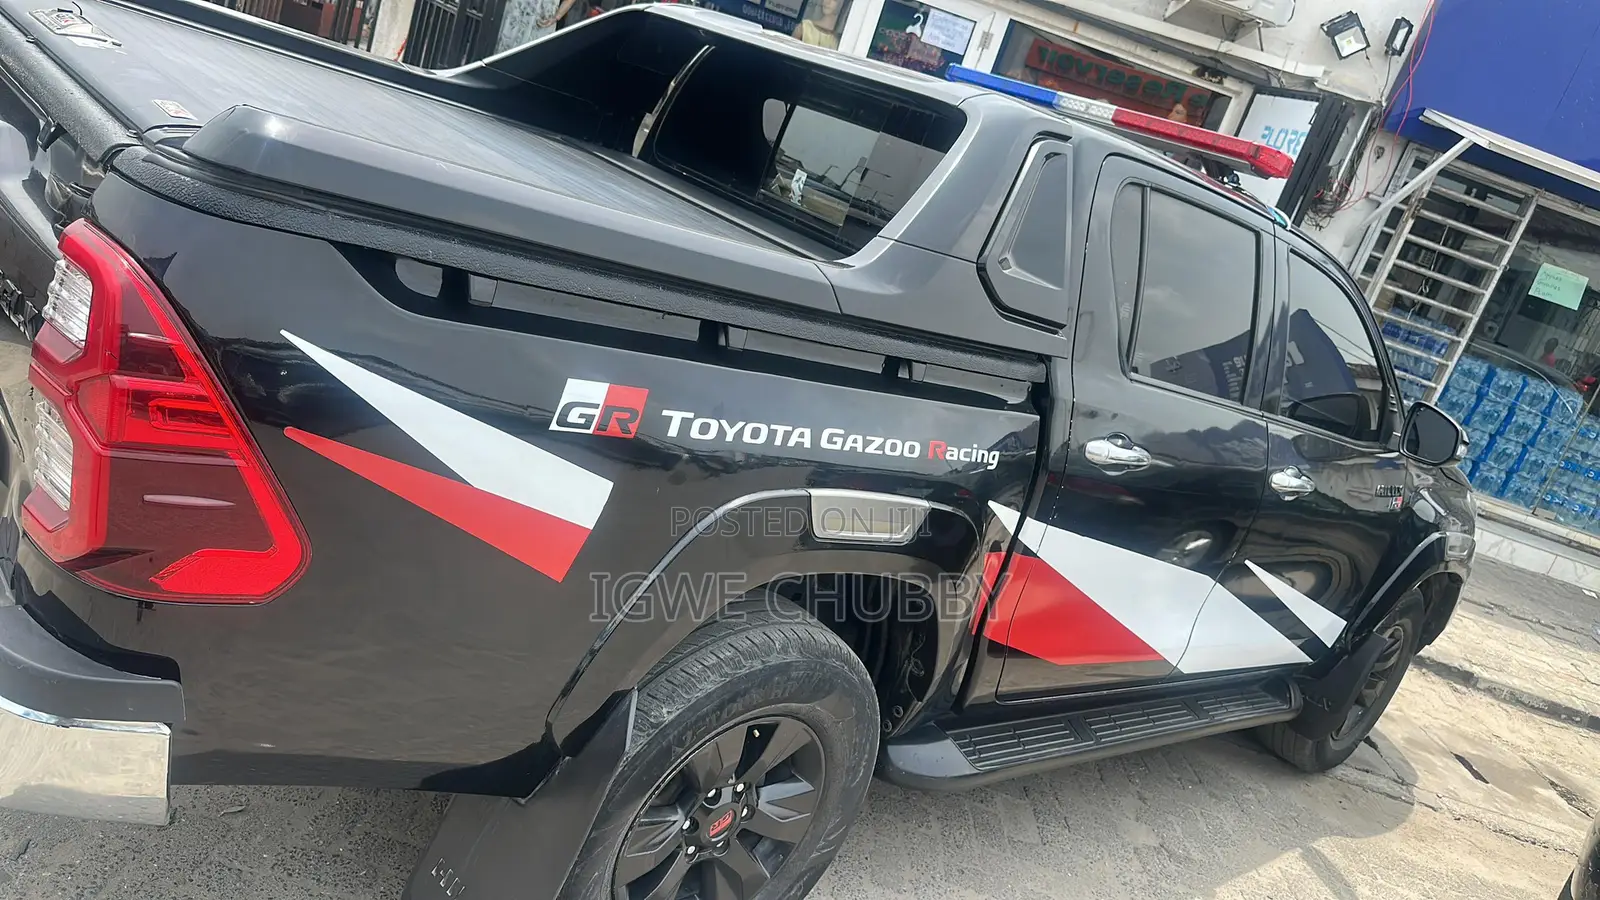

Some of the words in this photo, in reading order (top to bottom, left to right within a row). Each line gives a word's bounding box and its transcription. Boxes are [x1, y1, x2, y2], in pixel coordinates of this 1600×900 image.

[554, 398, 643, 436] GR
[661, 409, 811, 449] TOYOTA
[820, 427, 921, 459] GAZOO
[927, 440, 1000, 470] Racing
